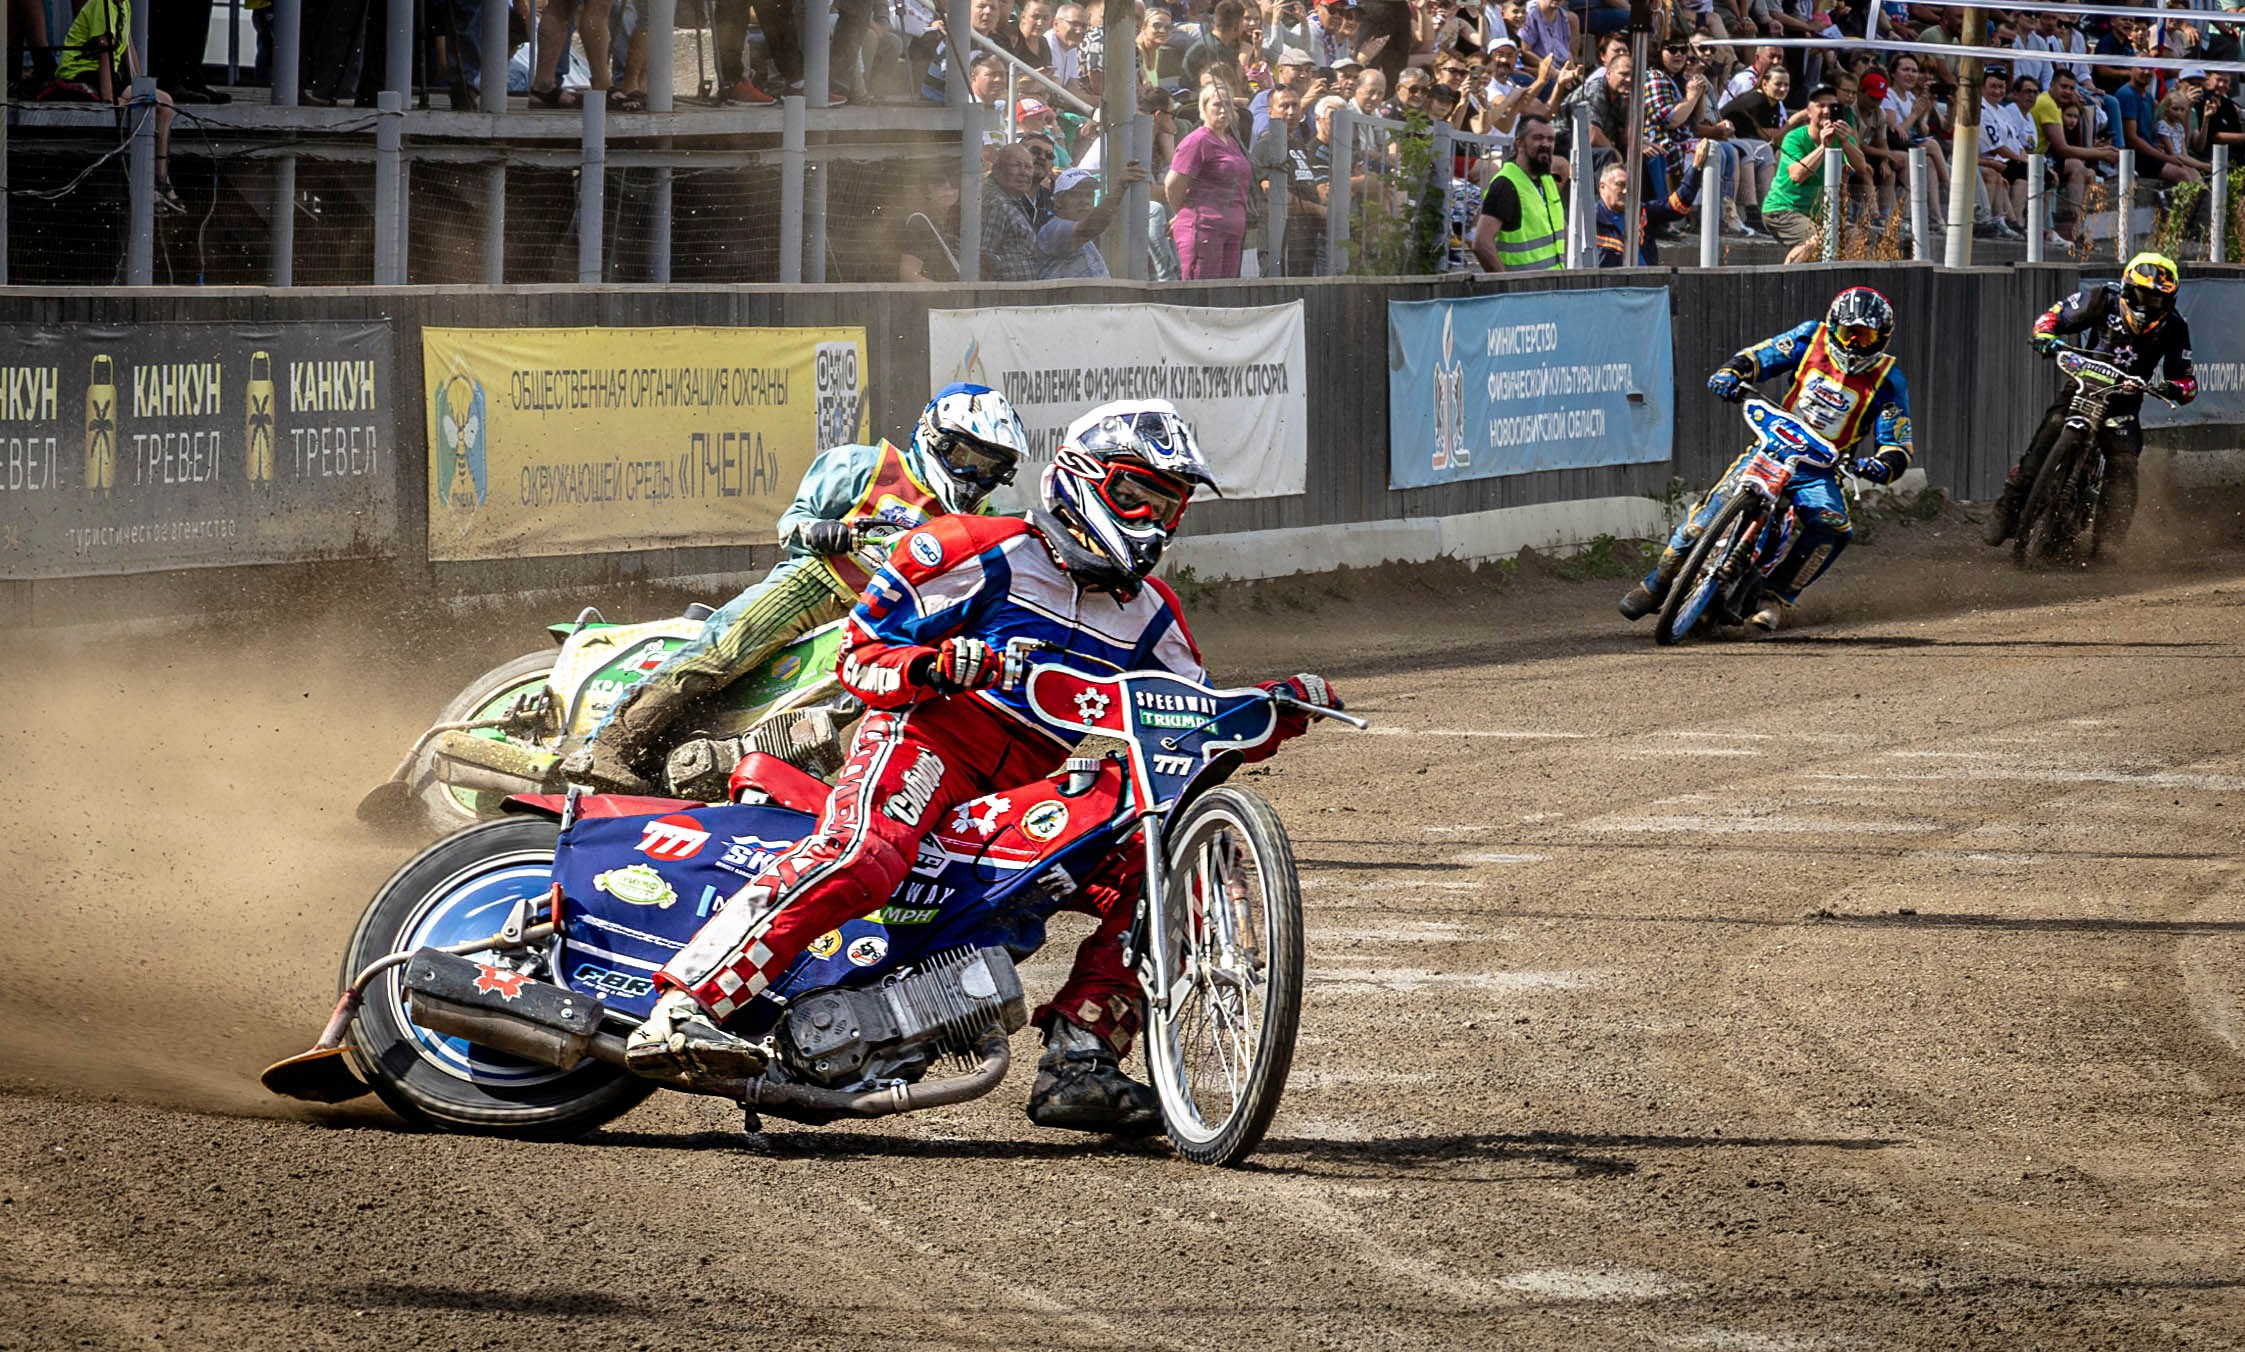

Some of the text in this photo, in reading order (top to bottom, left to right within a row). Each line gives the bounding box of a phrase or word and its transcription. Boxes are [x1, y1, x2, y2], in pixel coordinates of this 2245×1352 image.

[1487, 322, 1558, 356] МИНИСТЕРСТВО
[134, 363, 221, 417] КАНКУН
[291, 361, 375, 412] КАНКУН
[511, 367, 789, 420] ОБЩЕСТВЕННАЯ ОРГАНИЗАЦИЯ ОХРАНЫ
[1002, 356, 1289, 404] УПРАВЛЕНИЕ ФИЗИЧЕСКОЙ КУЛЬТУРЫ И СПОРТА
[1488, 362, 1547, 401] ФИЗИЧЕСКОЙ
[1549, 365, 1594, 397] КУЛЬТУРЫ
[1602, 363, 1633, 393] СПОРТА
[2210, 363, 2239, 391] СПОРТА
[1568, 409, 1606, 438] ОБЛАСТИ
[133, 431, 220, 486] ТРЕВЕЛ
[291, 426, 376, 478] ТРЕВЕЛ
[520, 432, 778, 508] ОКРУЖАЮЩЕЙ СРЕДЫ «ПЧЕЛА»
[171, 519, 236, 541] агентство
[1135, 691, 1217, 716] SPEEDWAY
[1152, 754, 1195, 776] 777
[634, 820, 712, 858] 777
[891, 881, 955, 905] WAY
